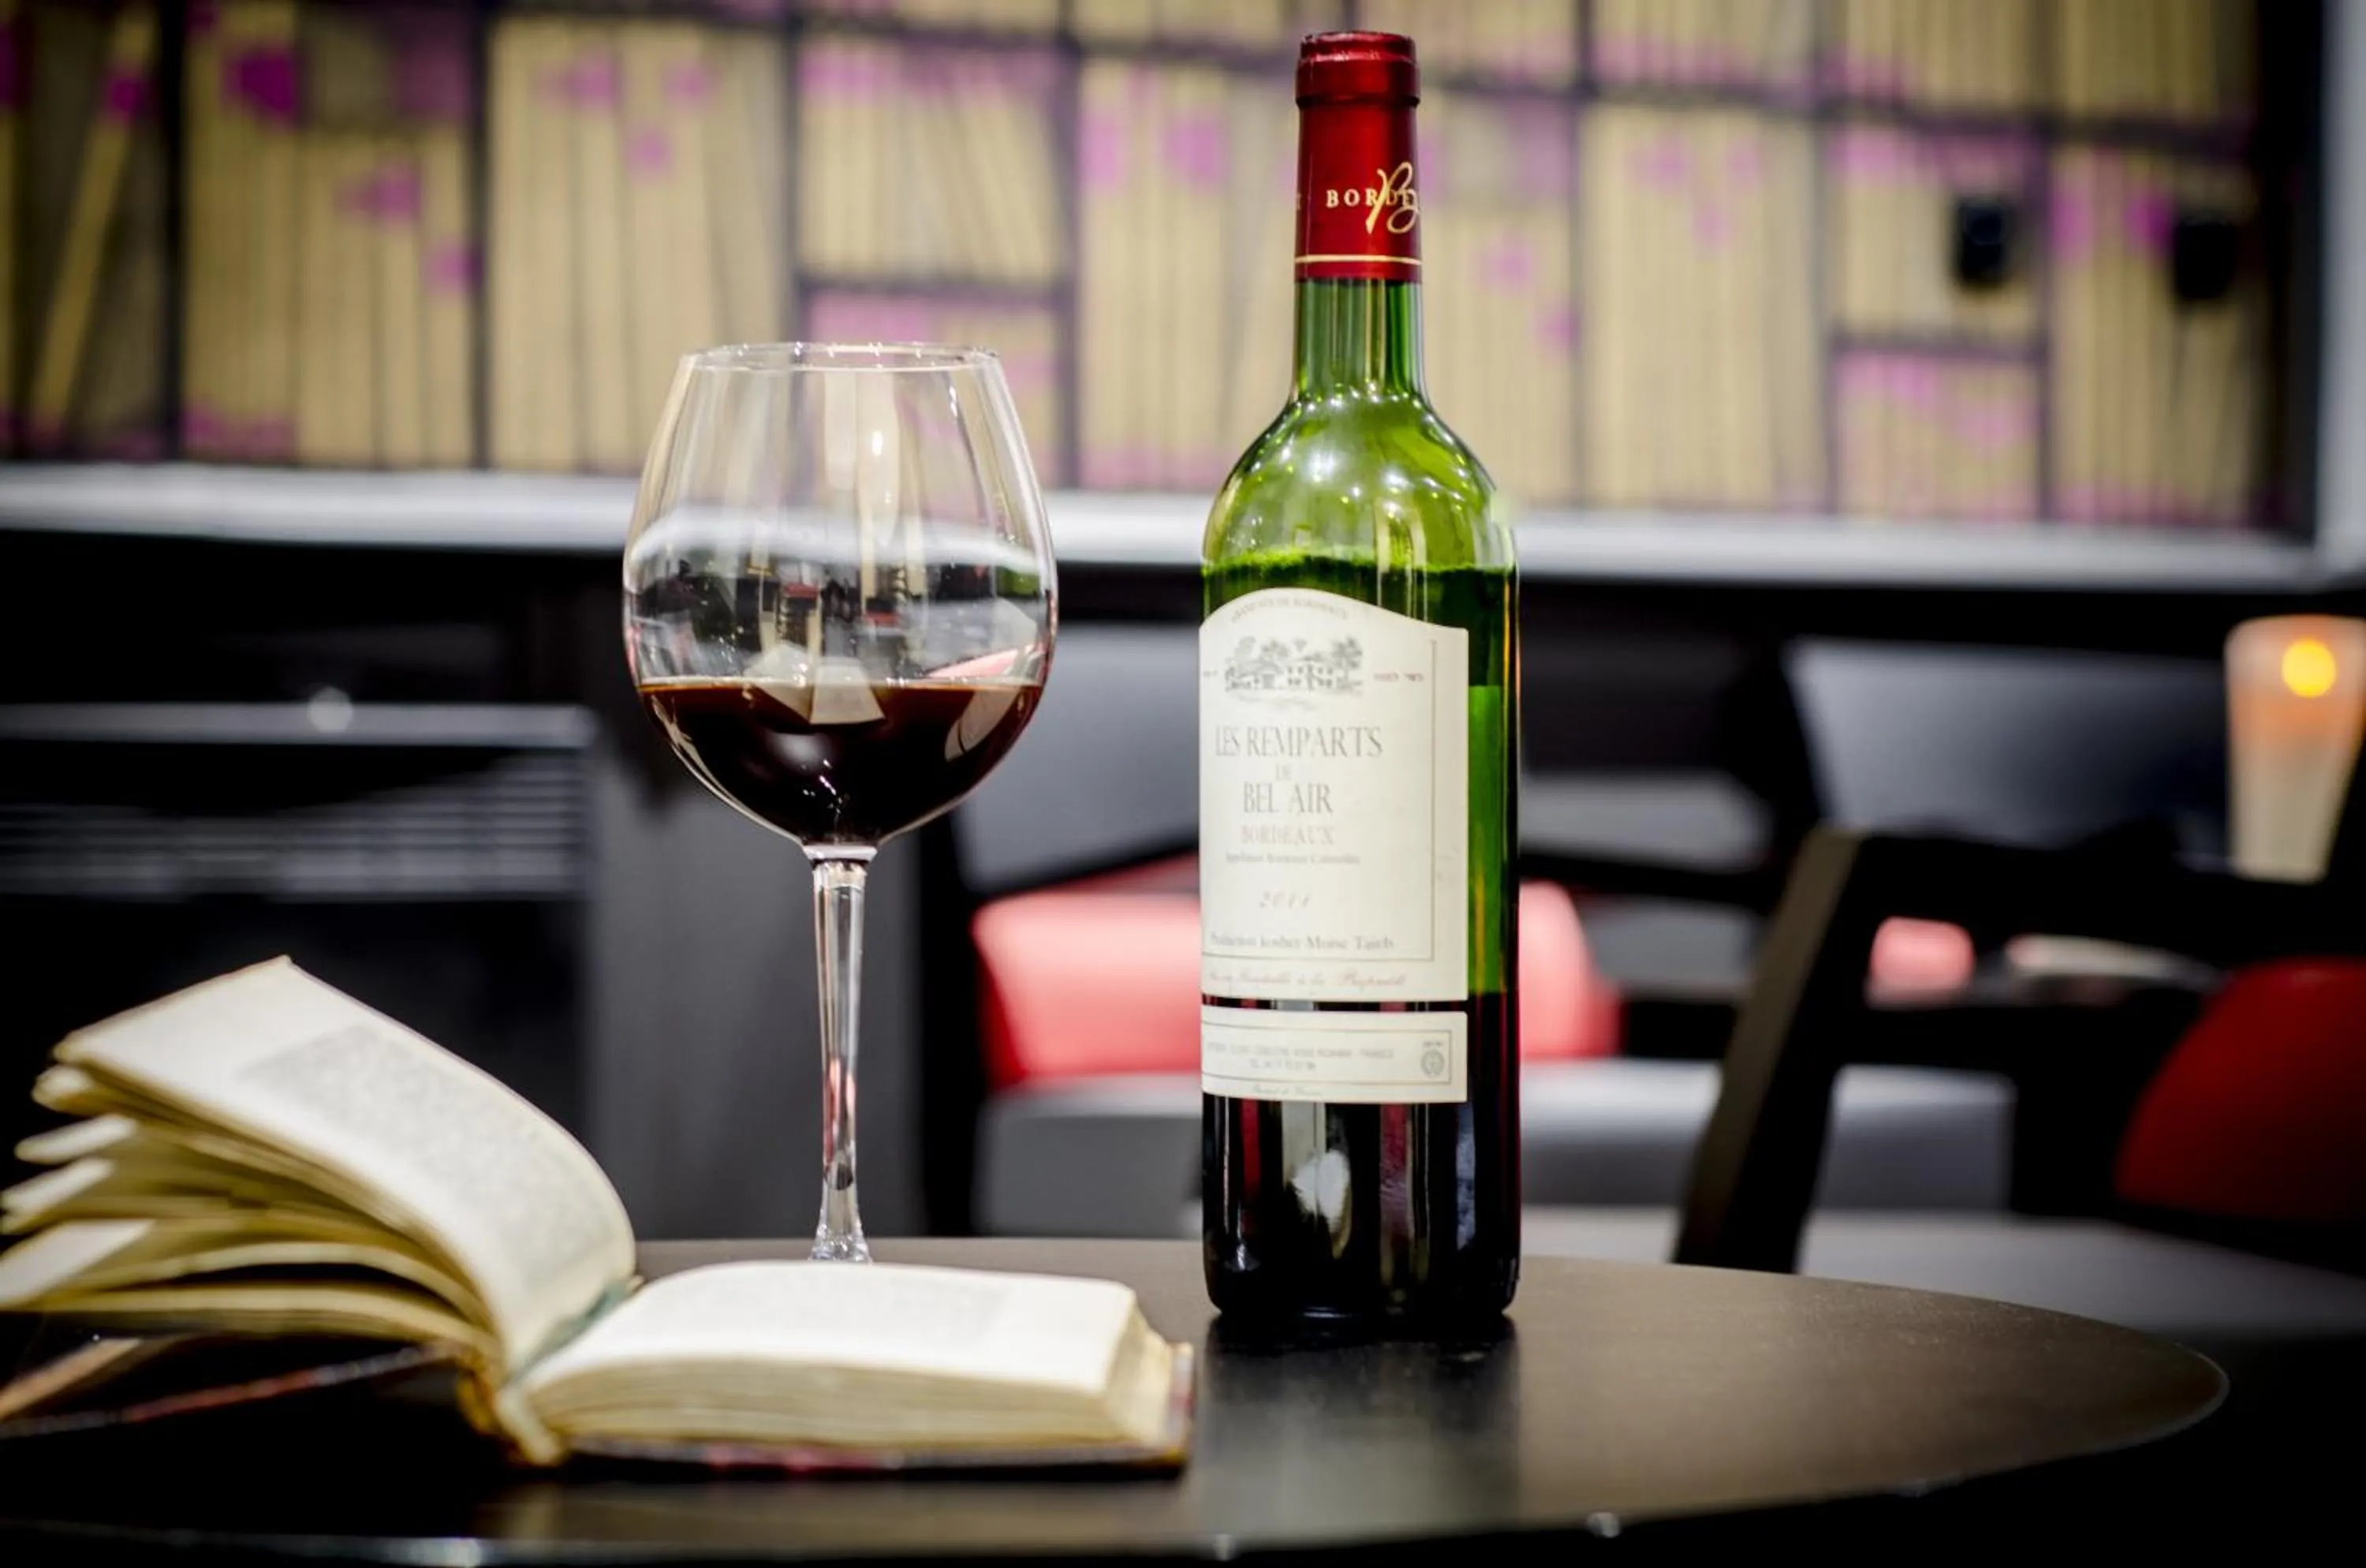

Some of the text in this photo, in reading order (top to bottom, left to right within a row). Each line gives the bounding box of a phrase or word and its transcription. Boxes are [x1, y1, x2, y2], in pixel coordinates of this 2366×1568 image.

[1215, 725, 1384, 758] LES REMPARTS
[1243, 782, 1334, 815] BEL AIR
[1241, 825, 1334, 846] BORDEAUX
